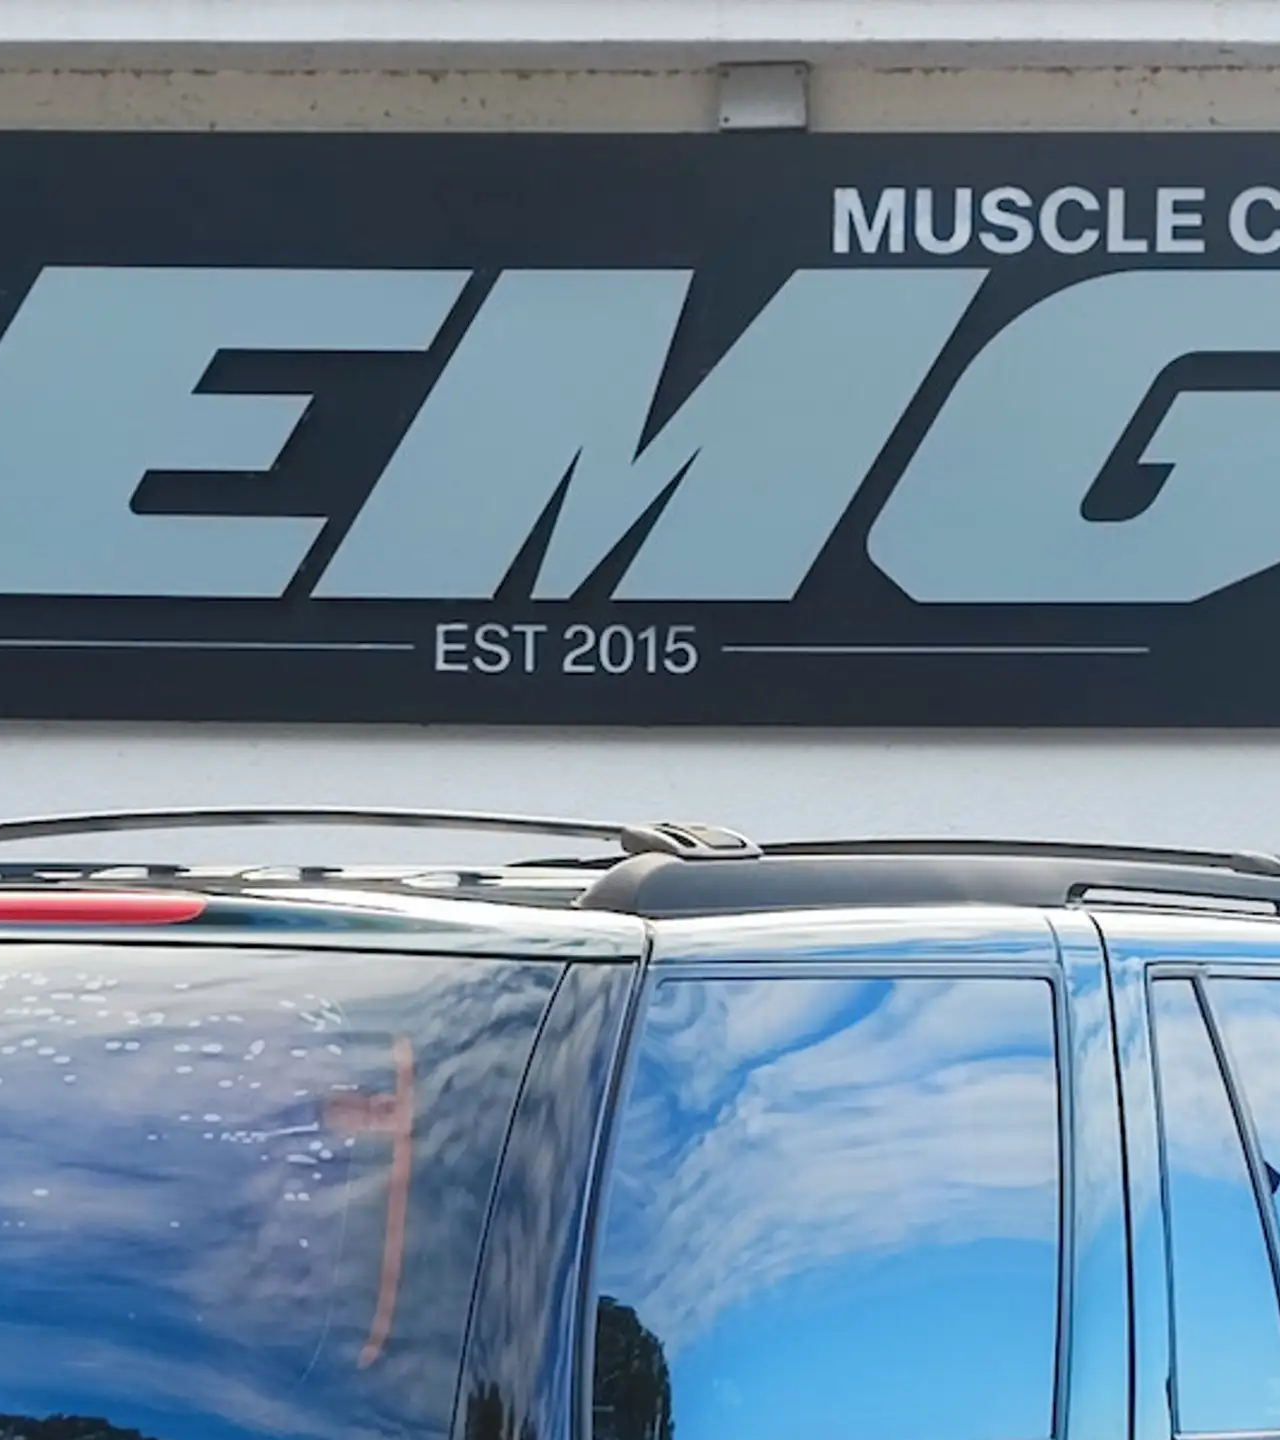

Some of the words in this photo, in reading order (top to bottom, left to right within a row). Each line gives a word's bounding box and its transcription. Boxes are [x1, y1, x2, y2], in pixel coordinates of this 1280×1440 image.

[832, 186, 1206, 254] MUSCLE
[435, 623, 548, 673] EST
[562, 623, 699, 674] 2015
